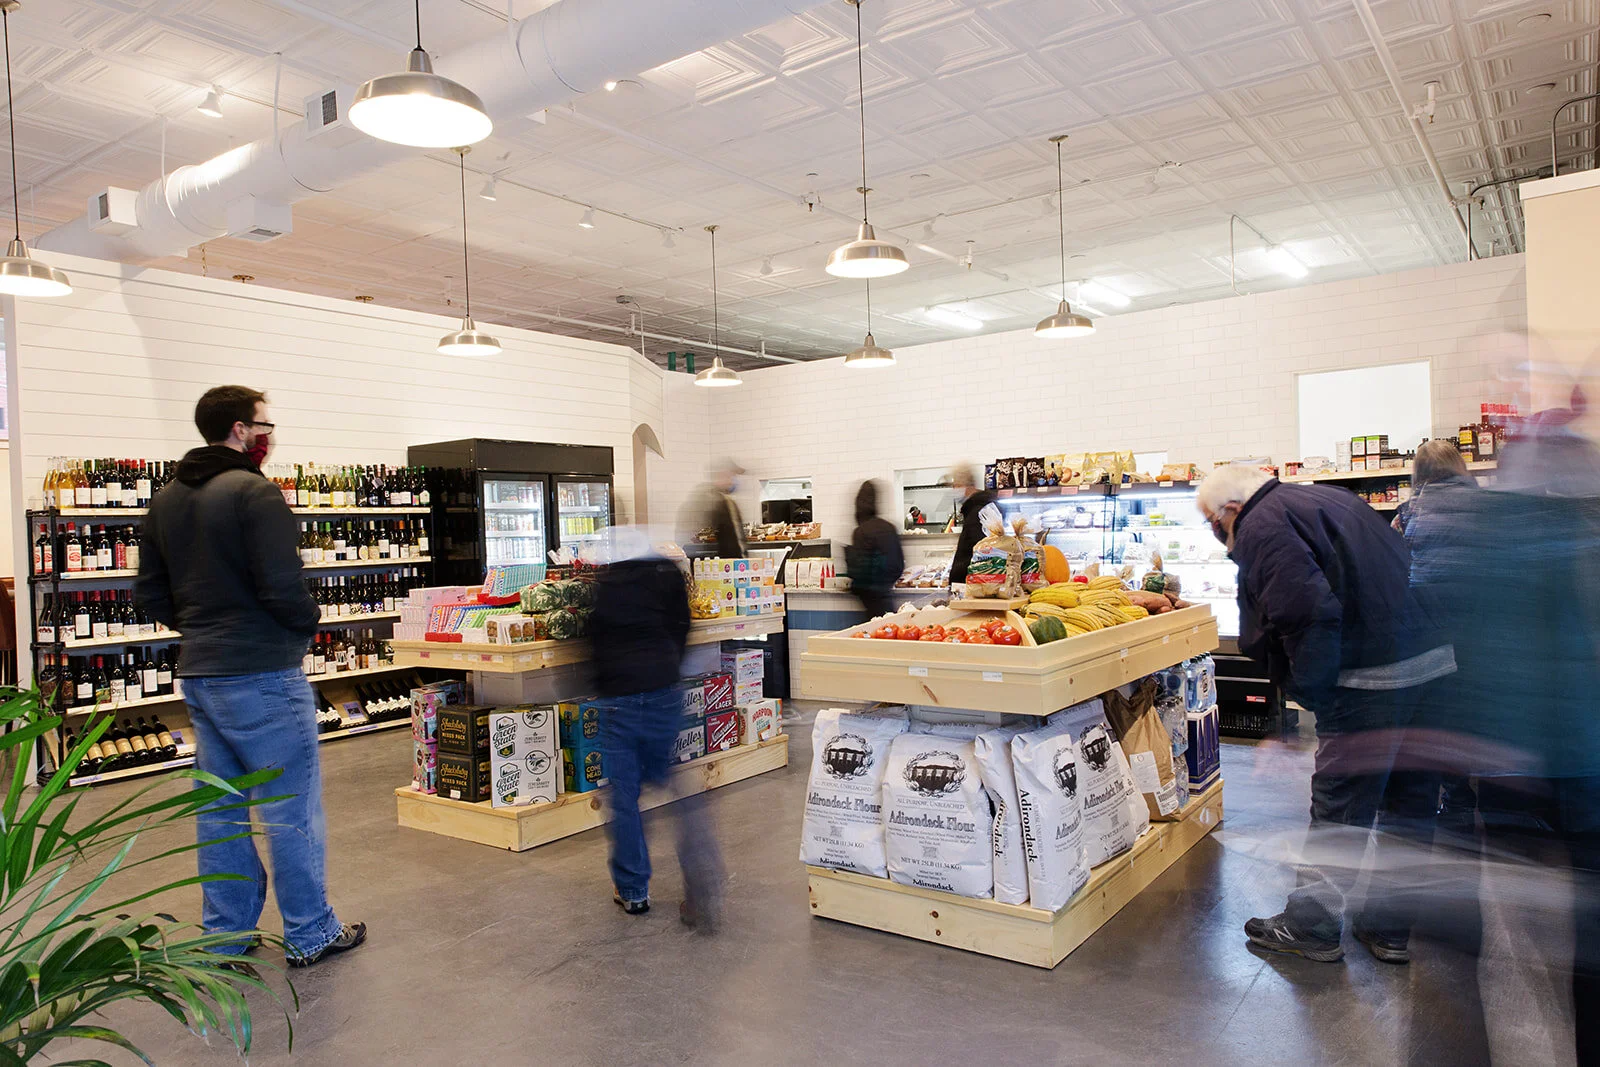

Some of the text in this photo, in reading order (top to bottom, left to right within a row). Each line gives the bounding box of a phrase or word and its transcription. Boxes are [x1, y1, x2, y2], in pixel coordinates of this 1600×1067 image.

[681, 692, 702, 708] elles
[715, 700, 732, 710] LAGER
[752, 708, 772, 722] HARPOON
[492, 726, 516, 742] Green
[584, 727, 598, 735] HEAD
[494, 734, 516, 746] State
[673, 730, 702, 756] Helles
[496, 771, 520, 788] Green
[498, 779, 520, 794] State
[807, 791, 881, 813] Adirondack Flour
[1084, 783, 1115, 810] Adirondack
[889, 810, 945, 828] Adirondack
[946, 816, 976, 832] Flour
[1020, 789, 1039, 863] Adirondack
[819, 858, 856, 868] Adirondack
[951, 863, 962, 871] KG)
[912, 879, 954, 892] Adirondack
[1273, 926, 1295, 943] N
